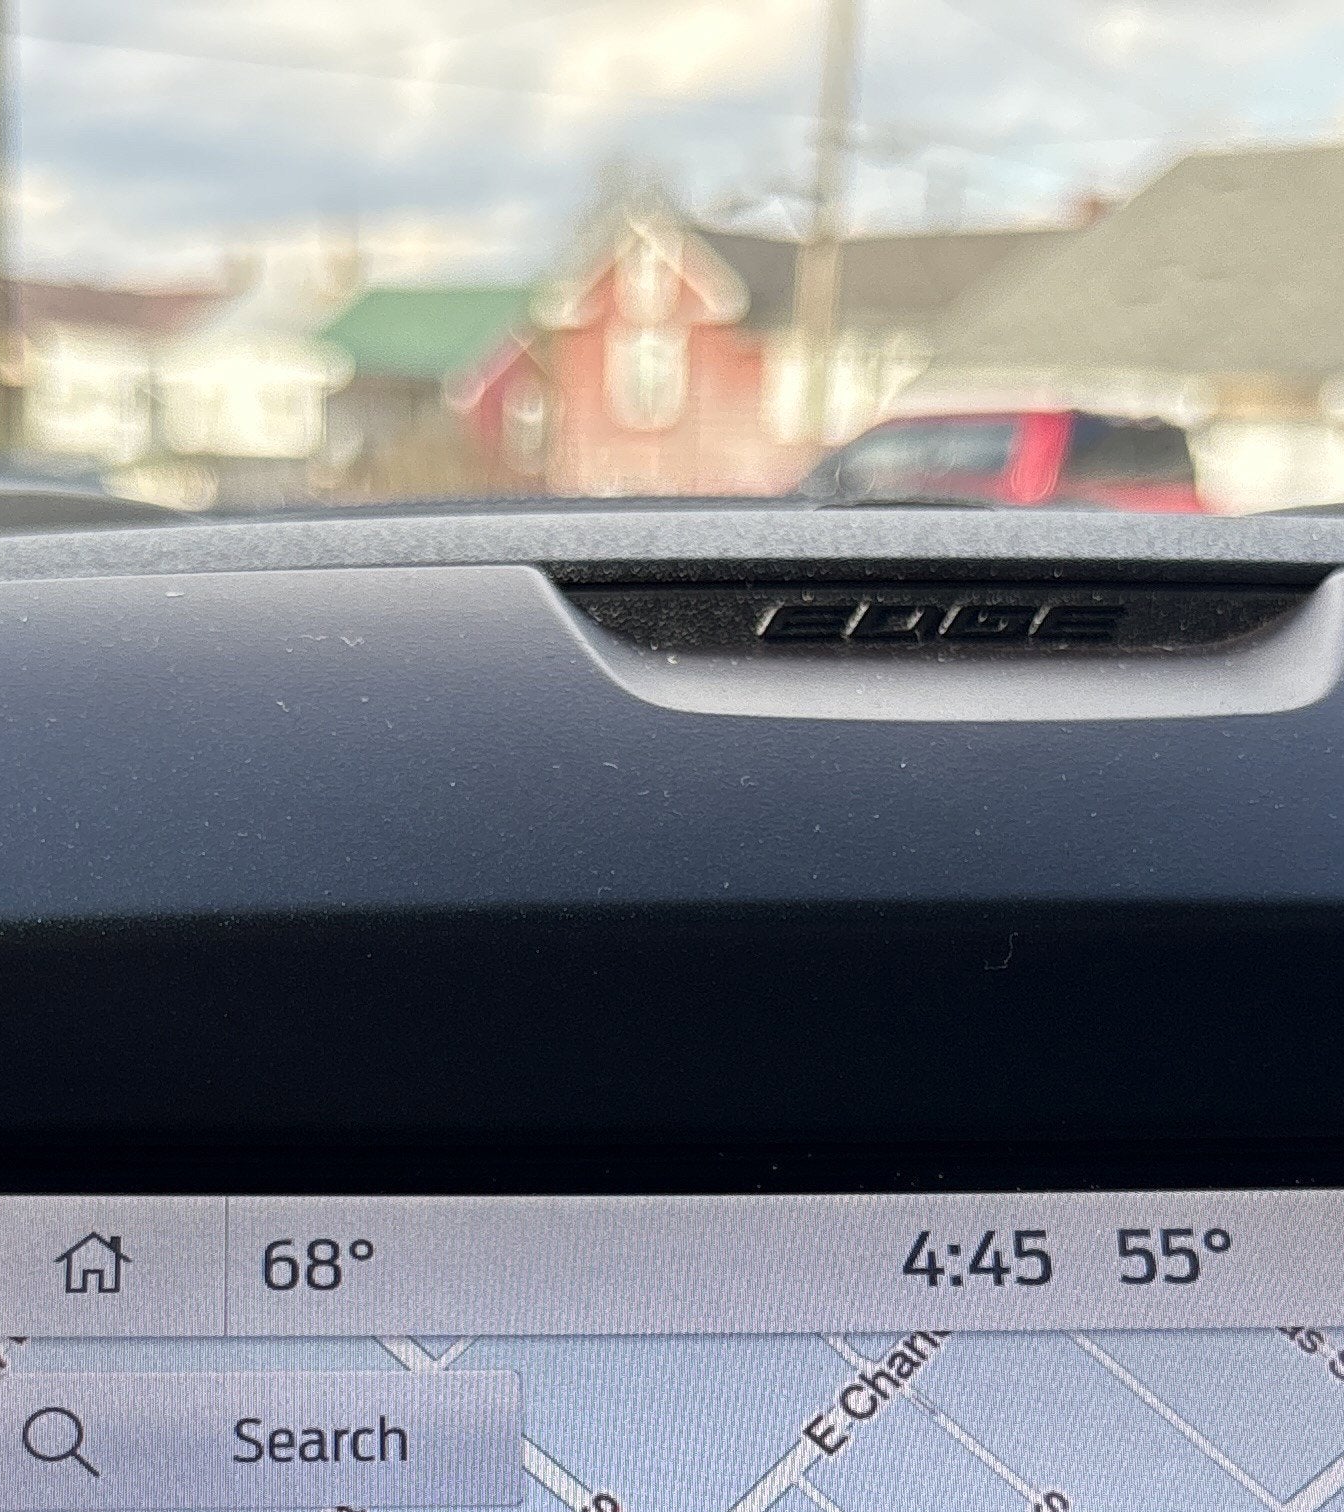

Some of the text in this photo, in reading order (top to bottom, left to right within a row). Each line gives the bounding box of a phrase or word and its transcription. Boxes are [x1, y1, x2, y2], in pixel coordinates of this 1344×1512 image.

[756, 601, 1127, 641] EDGE
[263, 1238, 376, 1292] 68°
[901, 1227, 1232, 1287] 4:45 55°
[233, 1416, 408, 1465] Search
[803, 1414, 849, 1456] E
